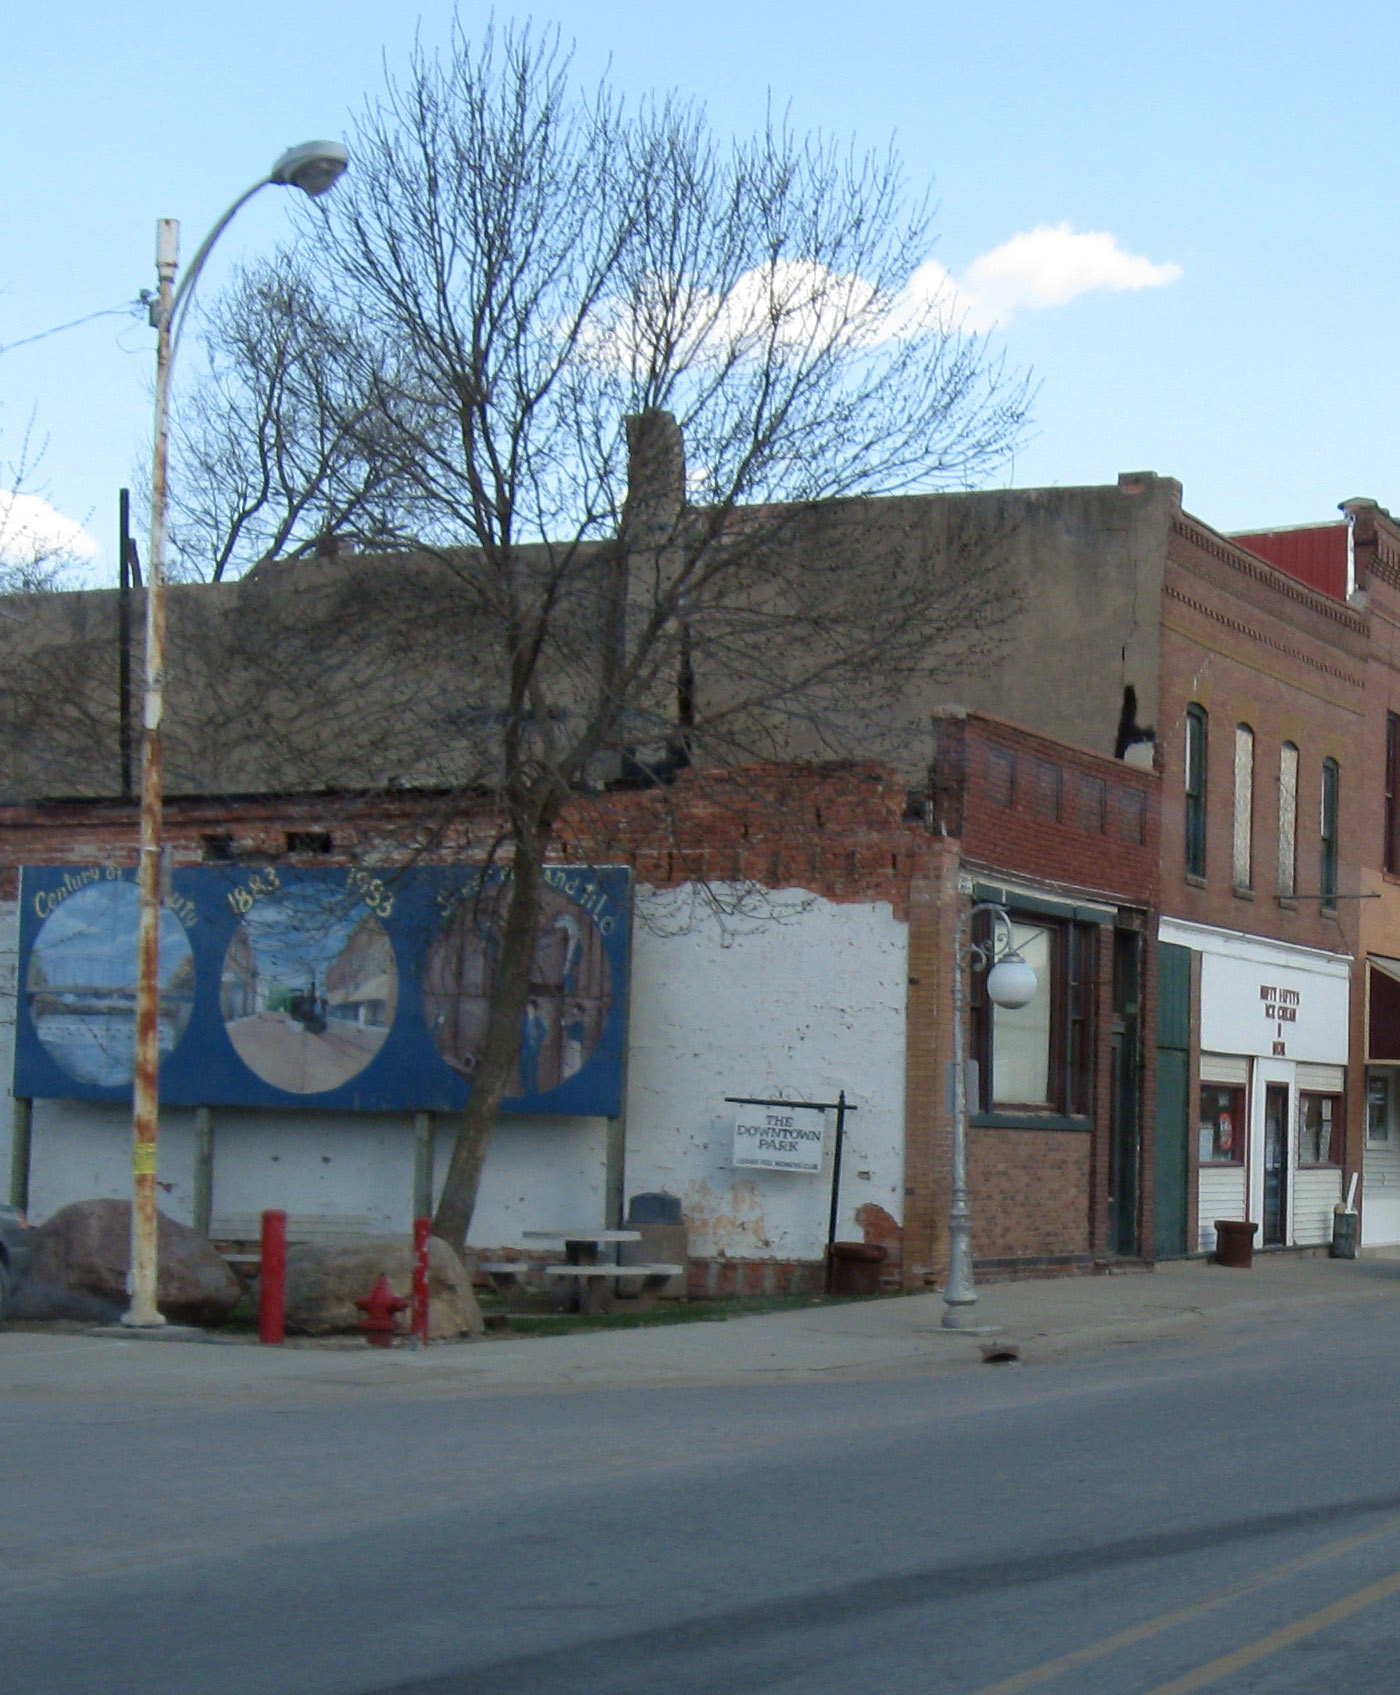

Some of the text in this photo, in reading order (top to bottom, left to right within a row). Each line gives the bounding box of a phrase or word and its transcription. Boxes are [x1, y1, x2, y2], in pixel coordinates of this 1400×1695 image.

[34, 866, 99, 919] Century
[226, 866, 281, 914] 1883
[1265, 1003, 1296, 1022] ICE CREAM
[766, 1115, 793, 1127] THE
[737, 1125, 821, 1141] DOWNTOWN
[758, 1139, 798, 1151] PARK
